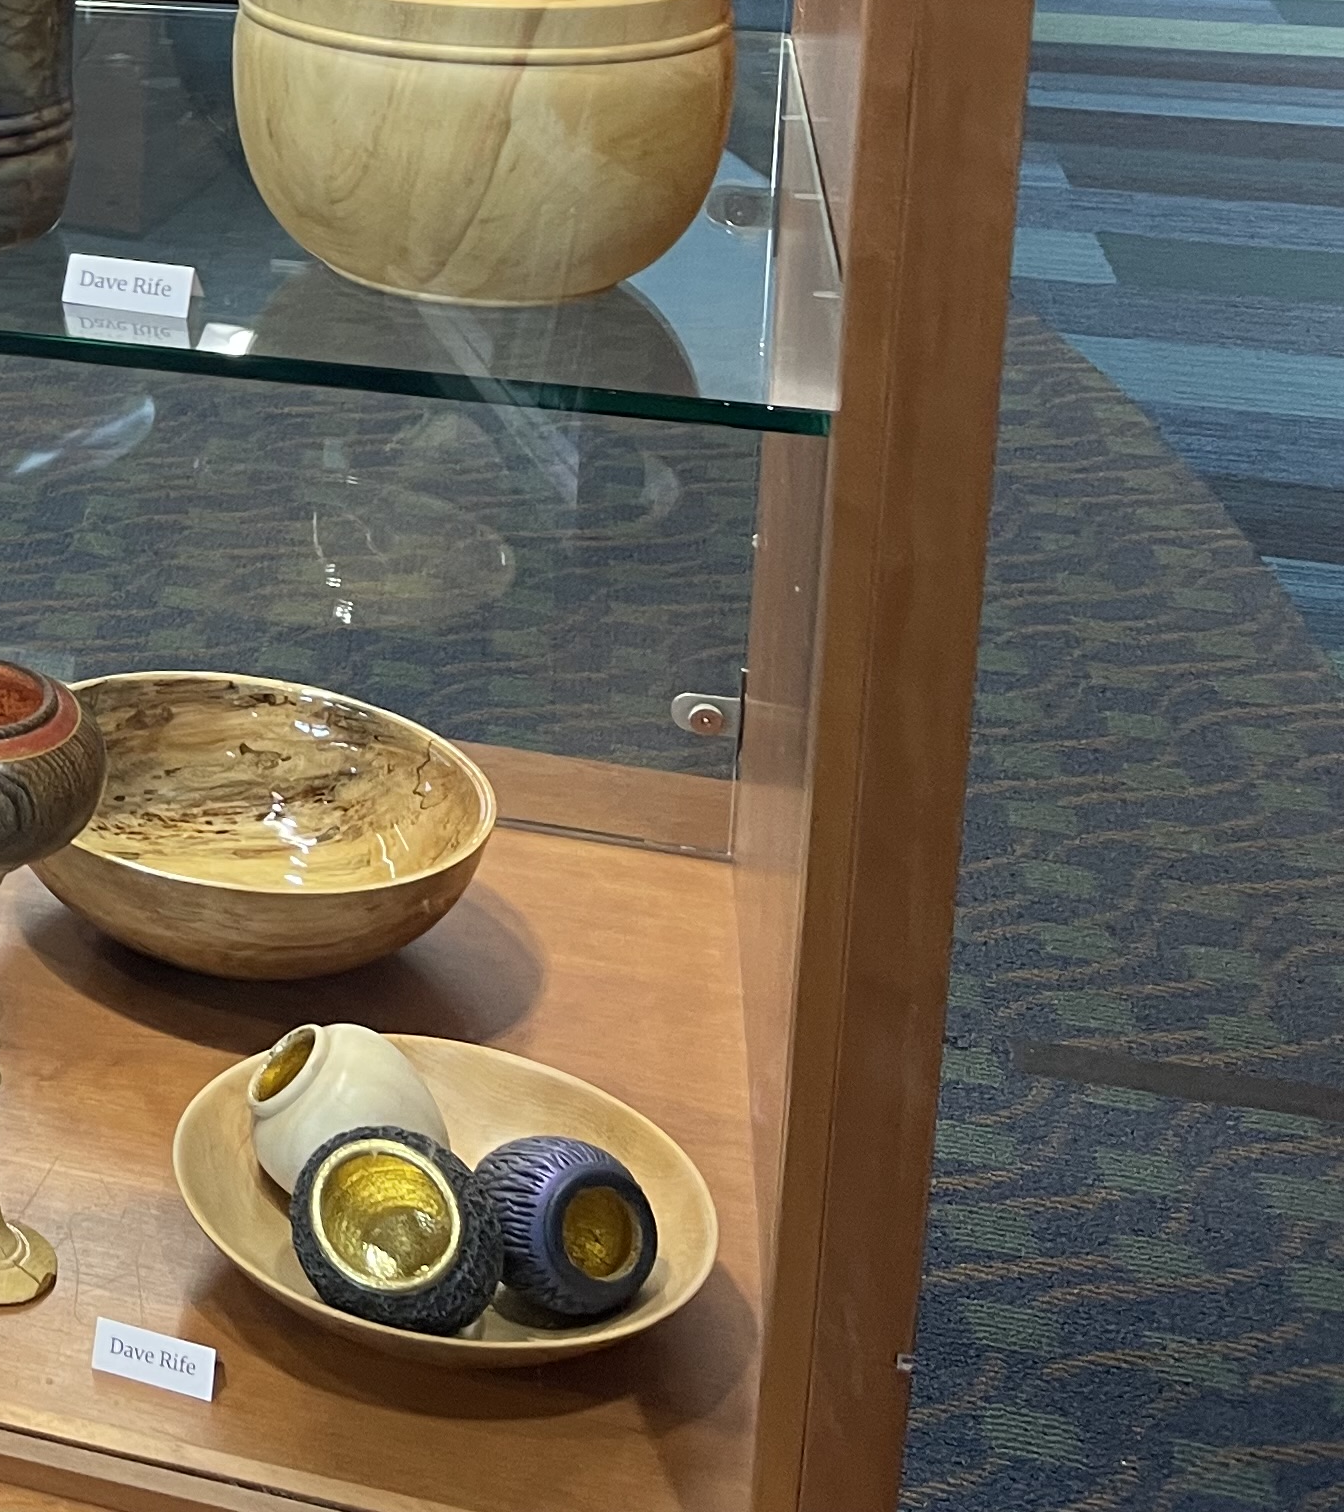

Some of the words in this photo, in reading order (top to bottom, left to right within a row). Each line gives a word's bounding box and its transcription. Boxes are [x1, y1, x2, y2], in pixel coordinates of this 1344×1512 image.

[79, 270, 128, 292] Dave
[132, 276, 172, 298] Rife
[110, 1337, 155, 1364] Dave
[159, 1349, 196, 1376] Rife
